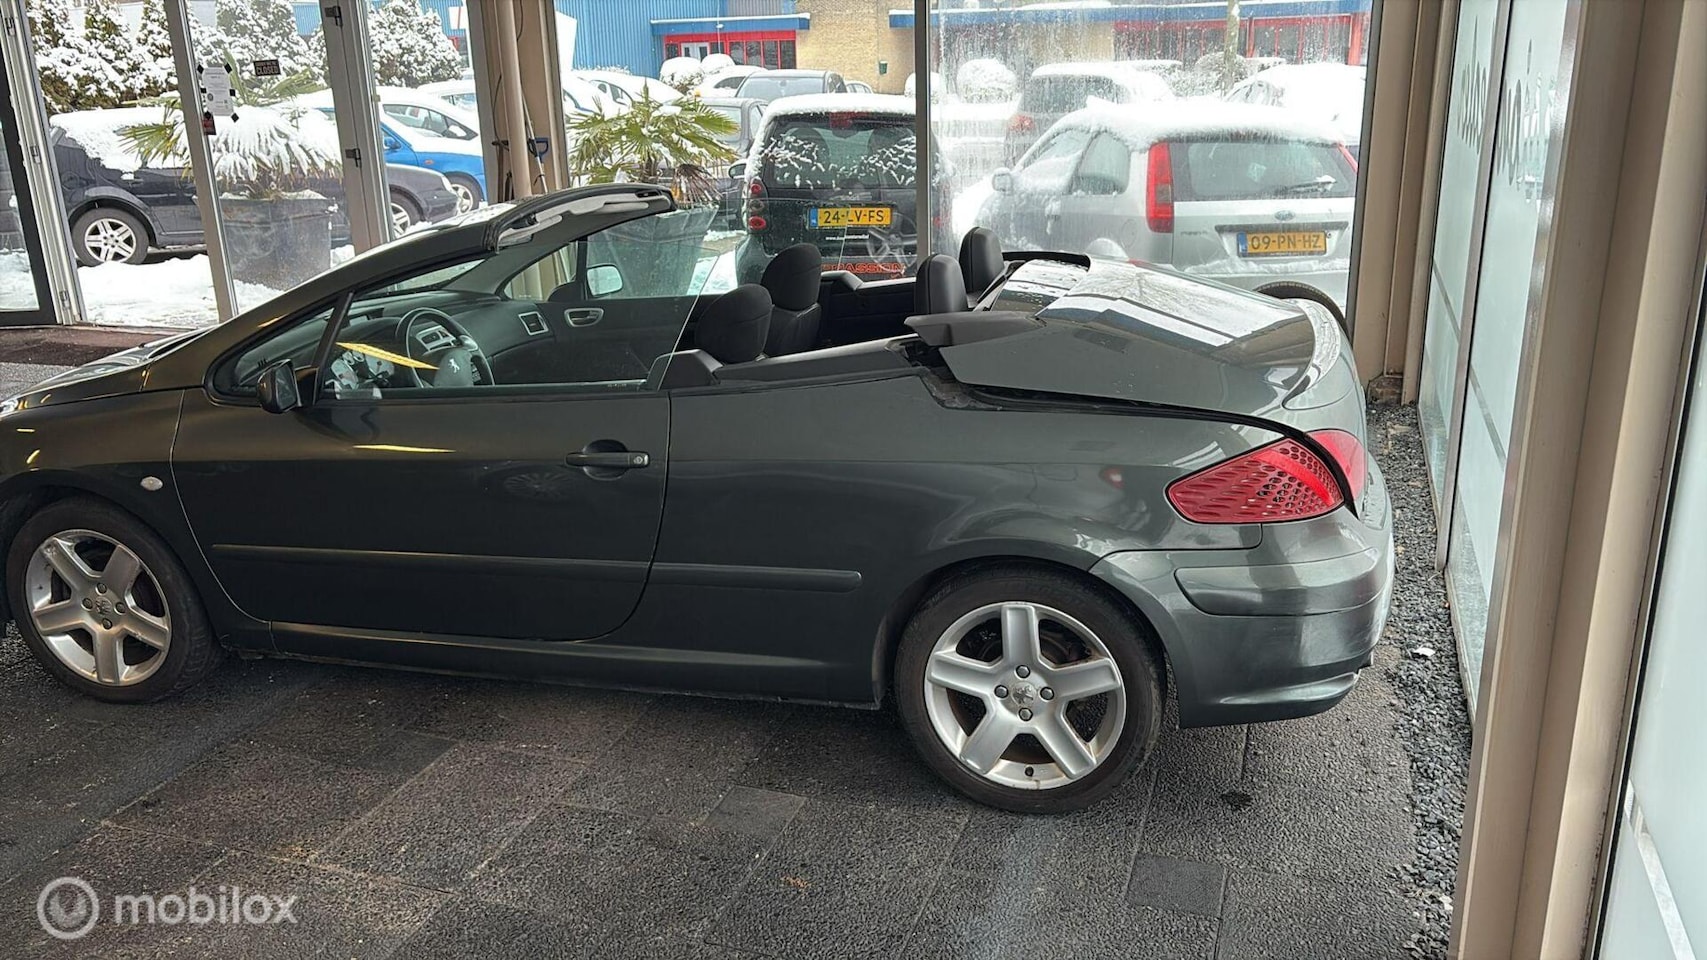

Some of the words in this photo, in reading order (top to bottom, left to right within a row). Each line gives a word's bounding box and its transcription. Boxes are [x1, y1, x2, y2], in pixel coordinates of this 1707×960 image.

[256, 66, 278, 75] CLOSED
[823, 209, 885, 224] 24-LV-FS
[1250, 234, 1322, 250] 09-PN-HZ
